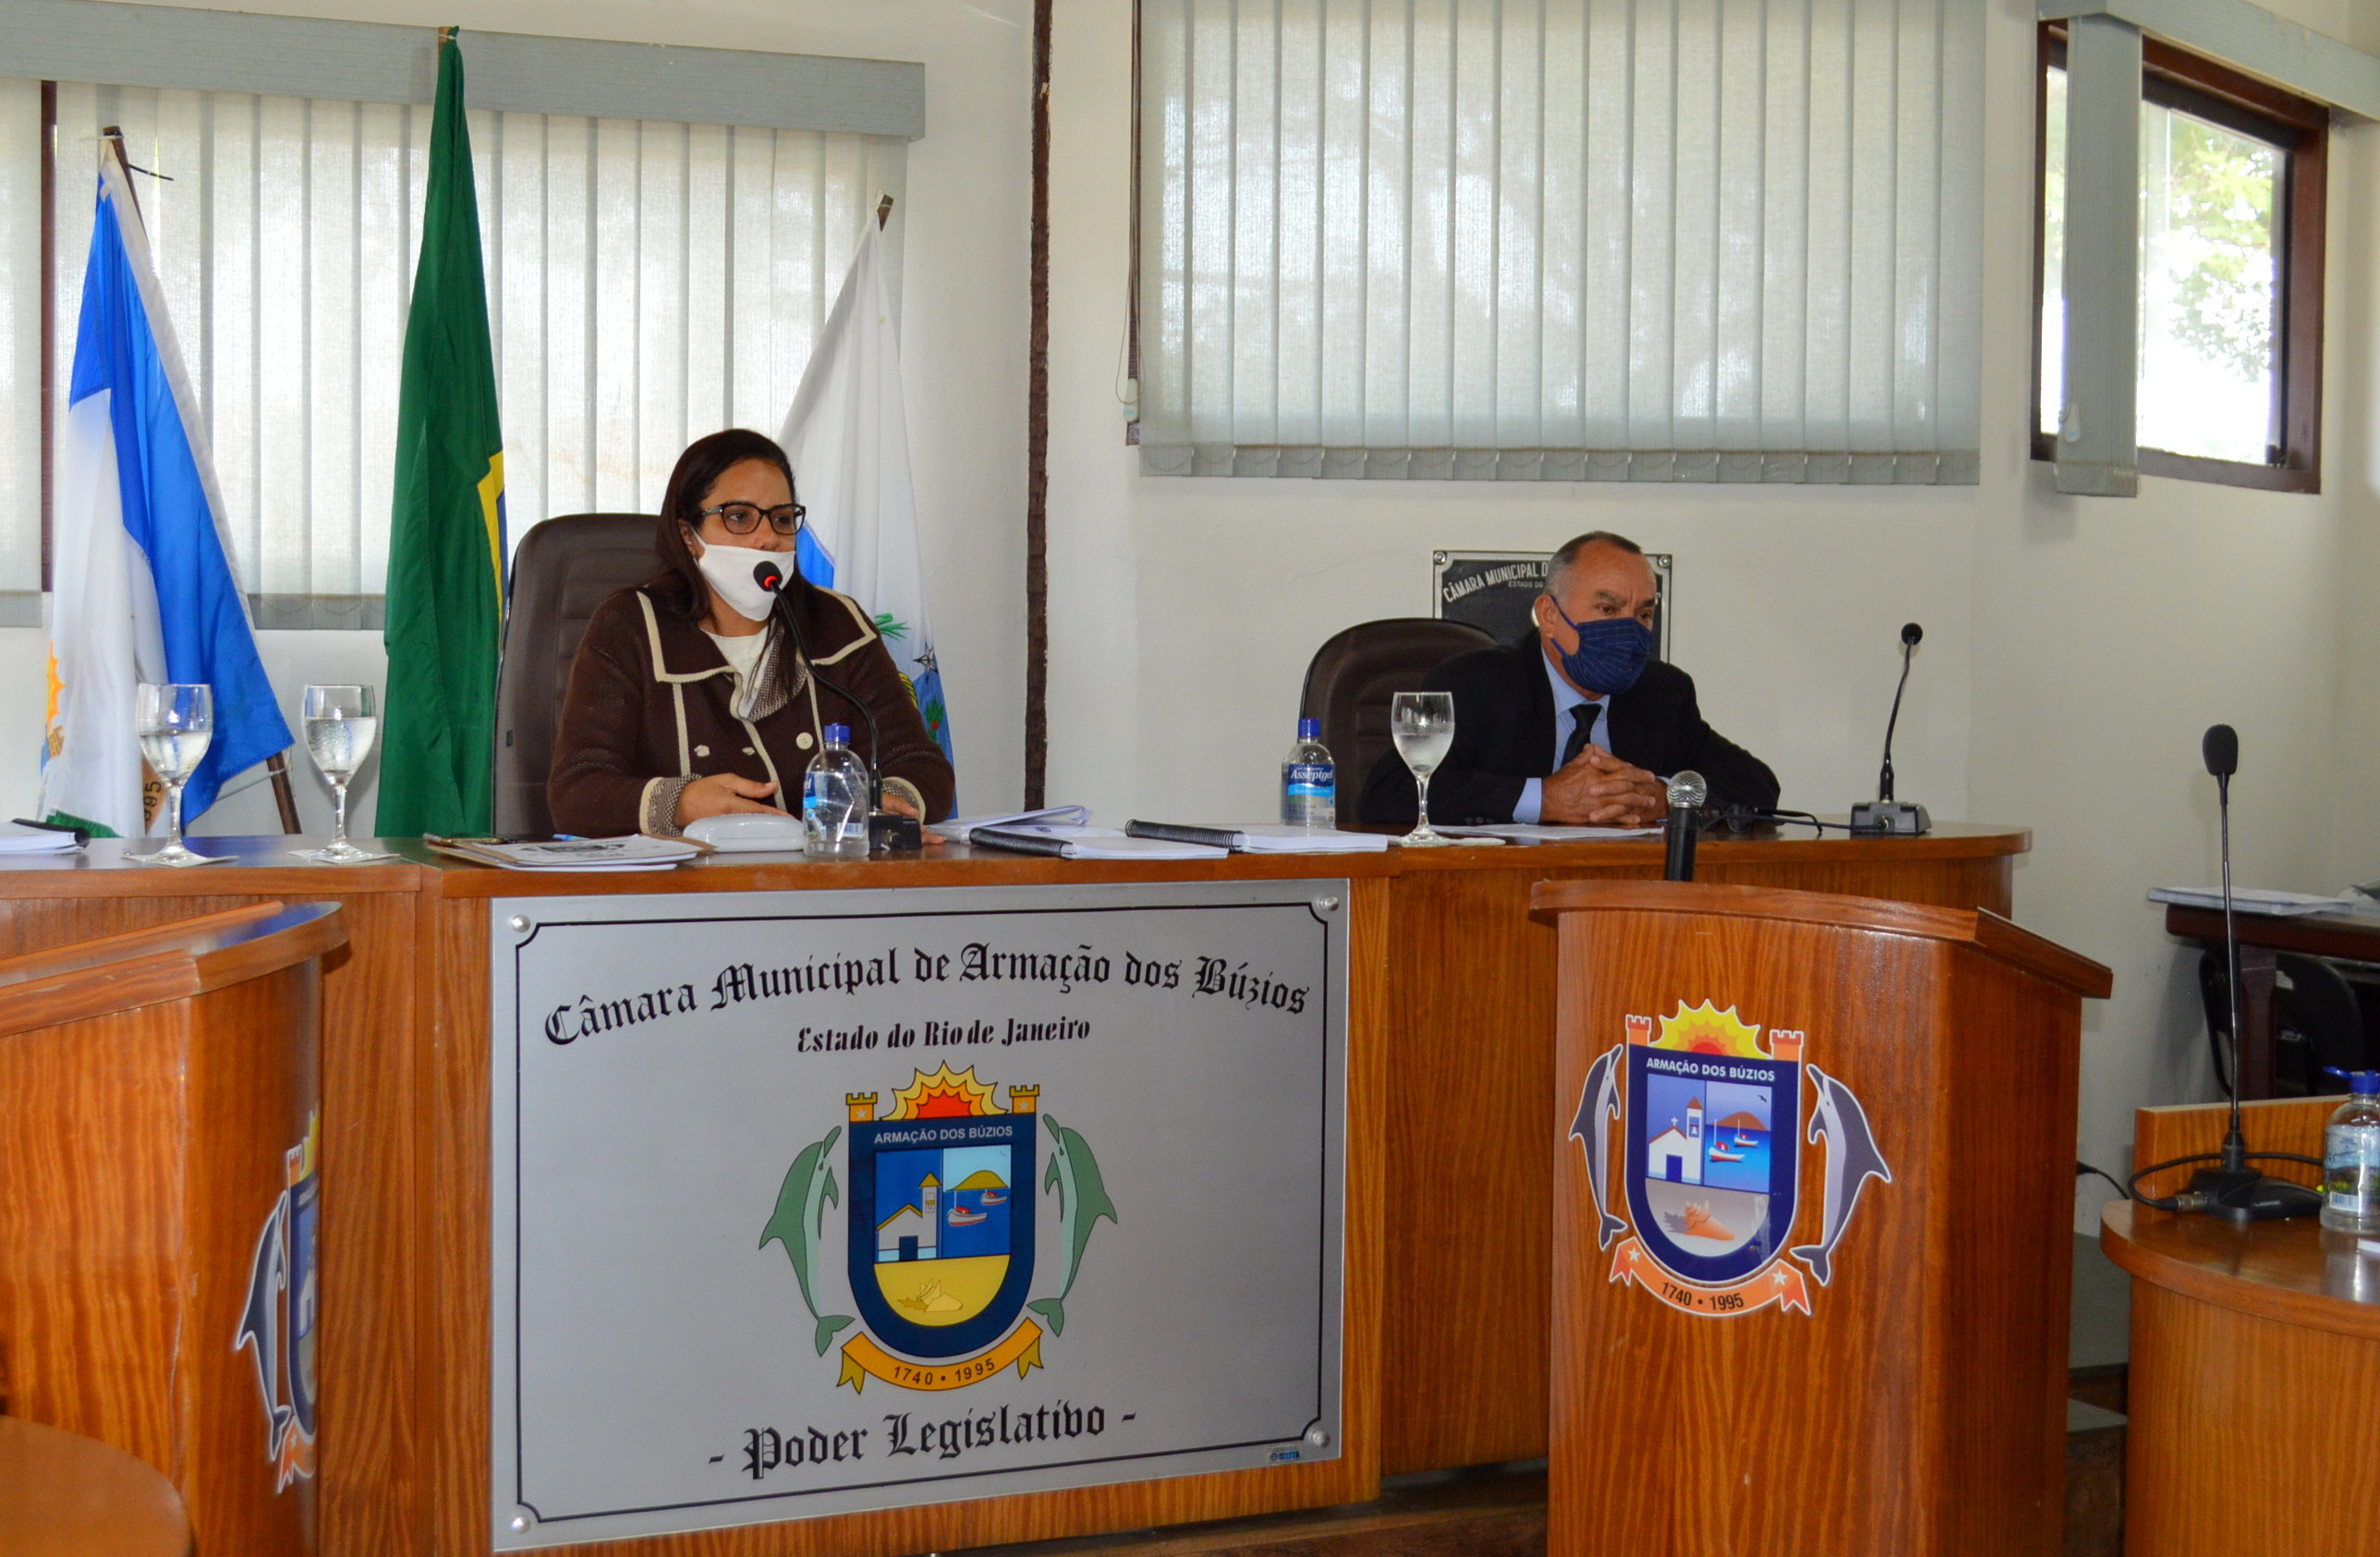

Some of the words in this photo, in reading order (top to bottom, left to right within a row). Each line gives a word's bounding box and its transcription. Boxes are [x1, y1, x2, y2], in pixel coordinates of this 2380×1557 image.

[1485, 562, 1539, 586] MUNICIPAL
[544, 981, 698, 1046] Câmara
[710, 947, 901, 1011] Municipal
[914, 947, 951, 982] de
[959, 942, 1111, 993] Armação
[1124, 950, 1183, 990] dos
[1192, 955, 1310, 1015] Búzios
[797, 1023, 879, 1052] Estado
[887, 1022, 916, 1050] do
[924, 1019, 963, 1047] Rio
[966, 1017, 994, 1045] de
[1002, 1016, 1090, 1047] Janeiro
[1646, 1057, 1699, 1075] ARMAÇÃO
[1701, 1064, 1726, 1077] DOS
[1729, 1064, 1775, 1081] BÚZIOS
[874, 1128, 937, 1144] ARMAÇÃO
[940, 1128, 965, 1140] DOS
[969, 1124, 1013, 1137] BÚZIOS
[1662, 1283, 1692, 1306] 1740
[1709, 1293, 1743, 1310] 1995
[893, 1366, 933, 1385] 1740
[954, 1357, 995, 1382] 1995
[741, 1425, 868, 1479] Poder
[882, 1400, 1105, 1459] Legislativo
